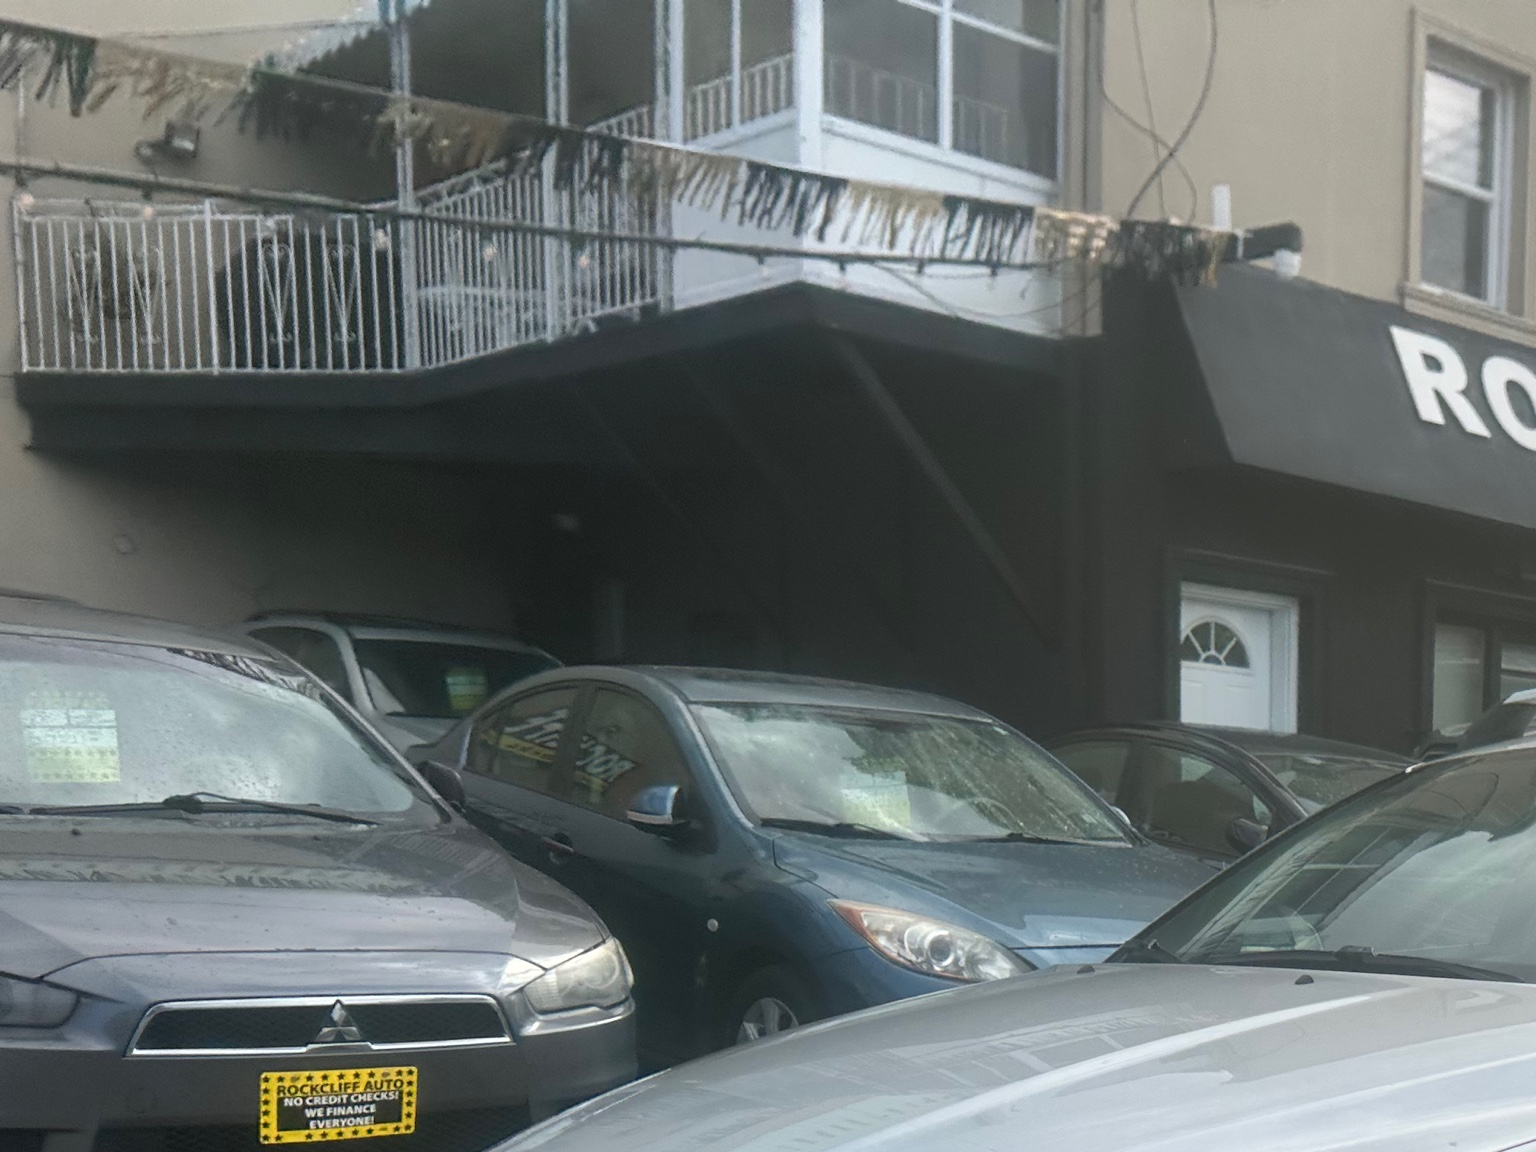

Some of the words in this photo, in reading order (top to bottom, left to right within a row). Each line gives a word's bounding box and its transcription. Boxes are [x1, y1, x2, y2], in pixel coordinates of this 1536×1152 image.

[276, 1081, 360, 1096] ROCKCLIFF
[363, 1078, 404, 1091] AUTO
[283, 1097, 303, 1107] NO
[305, 1094, 348, 1106] CREDIT
[350, 1090, 399, 1103] CHECKS!
[304, 1107, 324, 1118] WE
[326, 1104, 376, 1116] FINANCE
[309, 1117, 375, 1129] EVERYONE!
